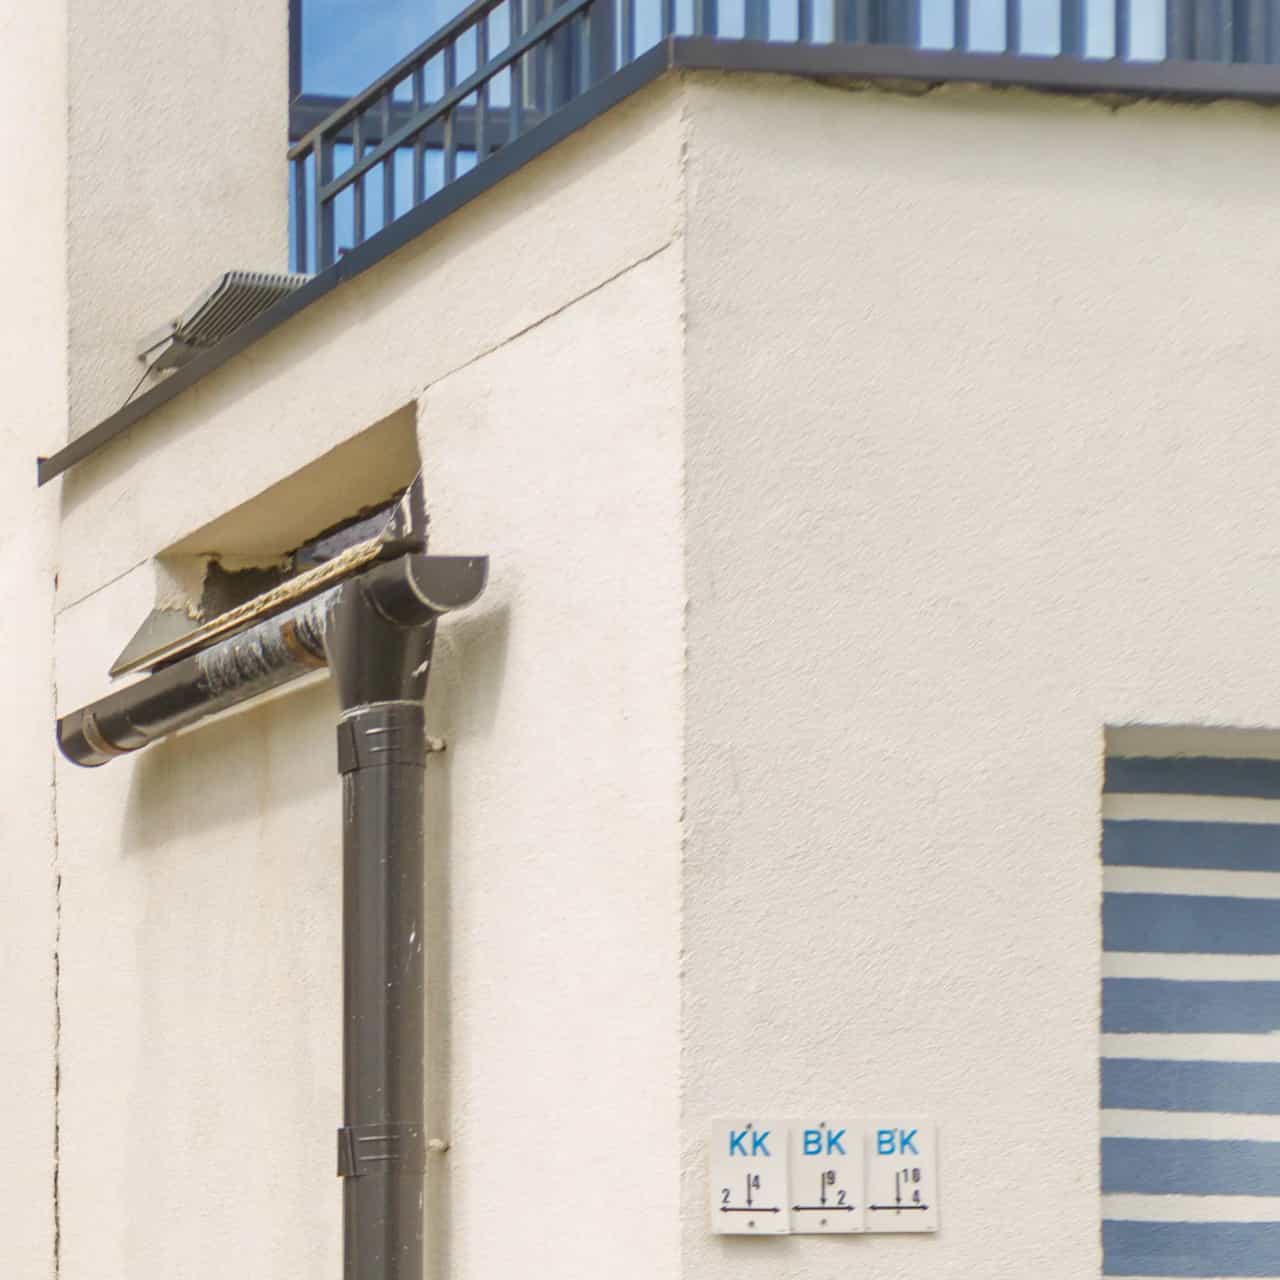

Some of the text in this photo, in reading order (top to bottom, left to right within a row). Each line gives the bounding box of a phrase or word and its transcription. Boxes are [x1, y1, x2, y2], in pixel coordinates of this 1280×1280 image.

[752, 1174, 761, 1190] 4
[826, 1170, 836, 1186] 9
[721, 1188, 731, 1204] 2
[837, 1189, 847, 1205] 2
[912, 1189, 921, 1204] 4
